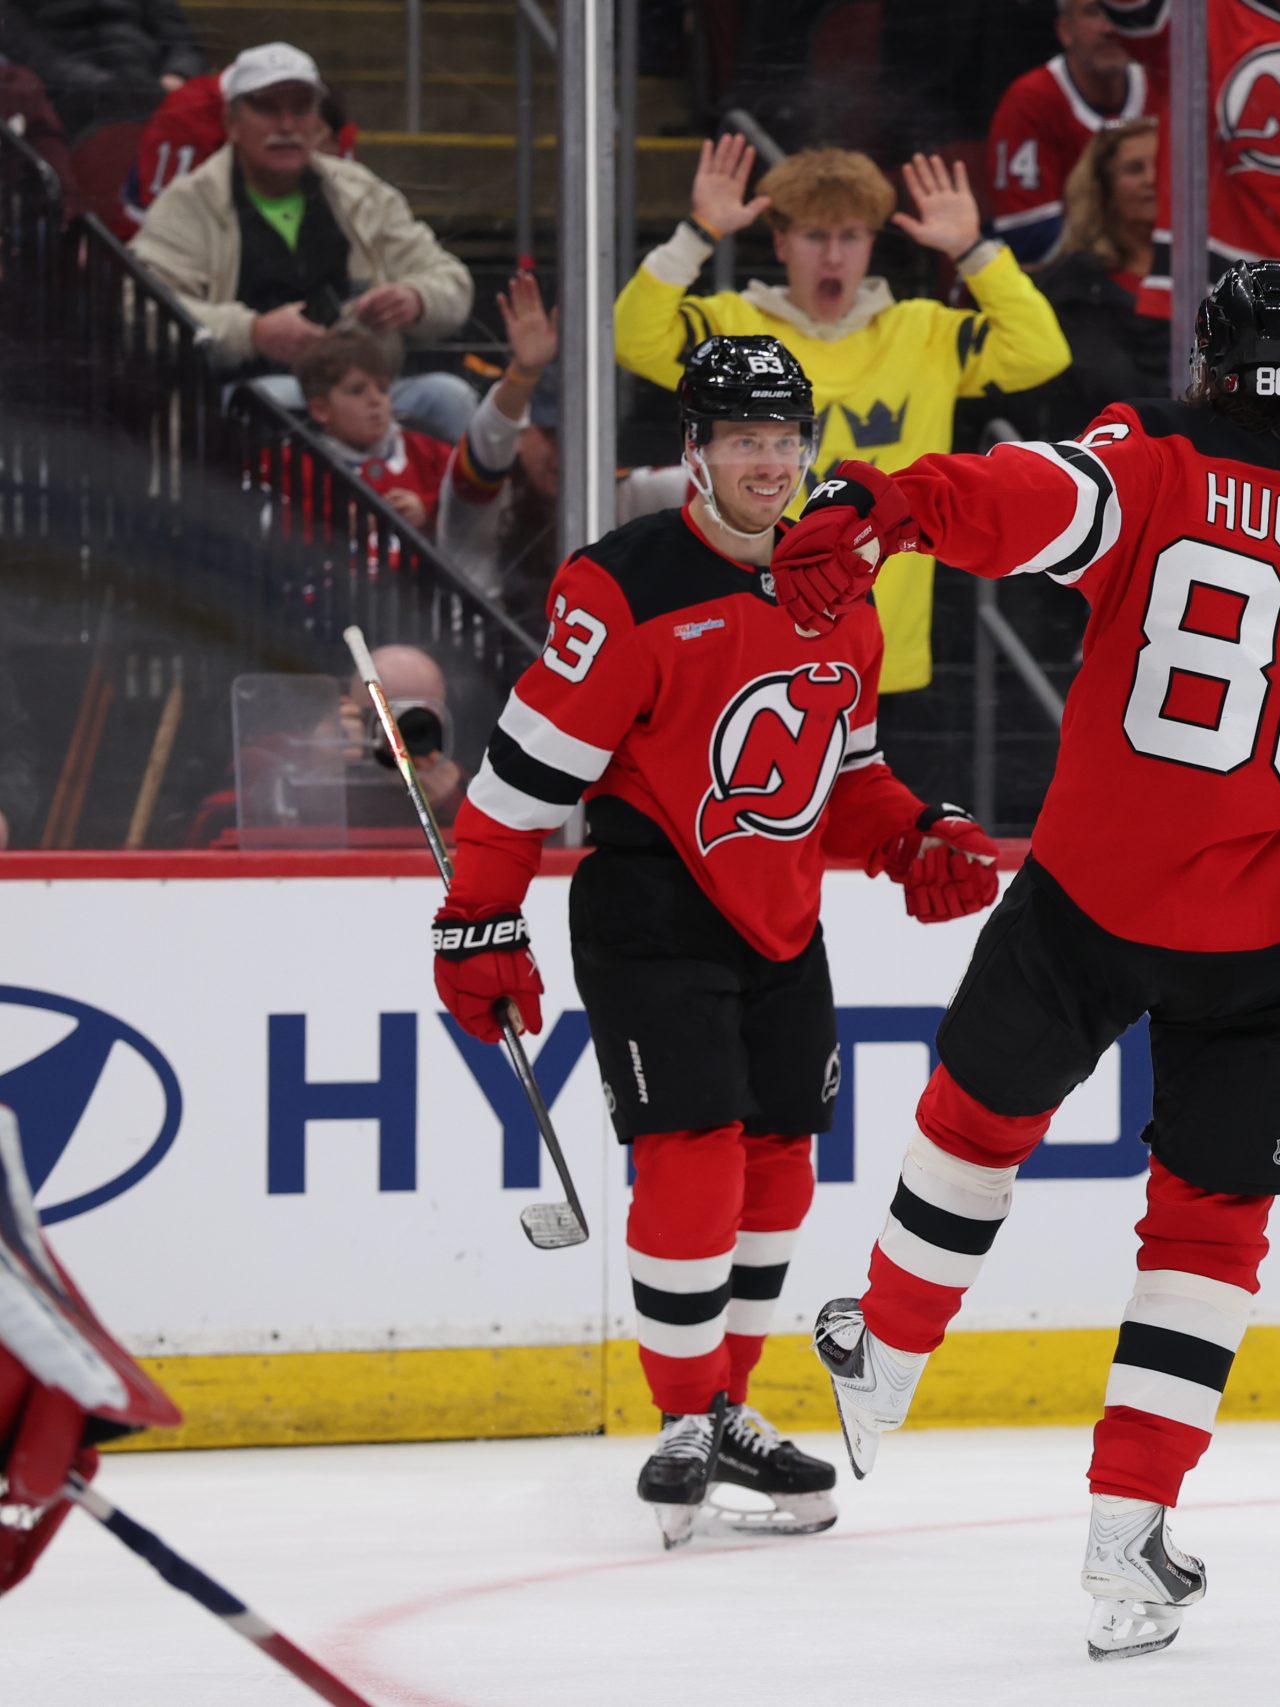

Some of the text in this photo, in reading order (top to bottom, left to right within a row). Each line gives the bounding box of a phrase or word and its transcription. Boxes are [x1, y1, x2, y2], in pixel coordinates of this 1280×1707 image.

[994, 138, 1040, 190] 14
[748, 356, 784, 375] 63
[751, 390, 792, 398] BAUER
[431, 918, 530, 950] BAUER
[628, 1039, 649, 1105] BAUER
[1166, 1563, 1192, 1587] BAUER
